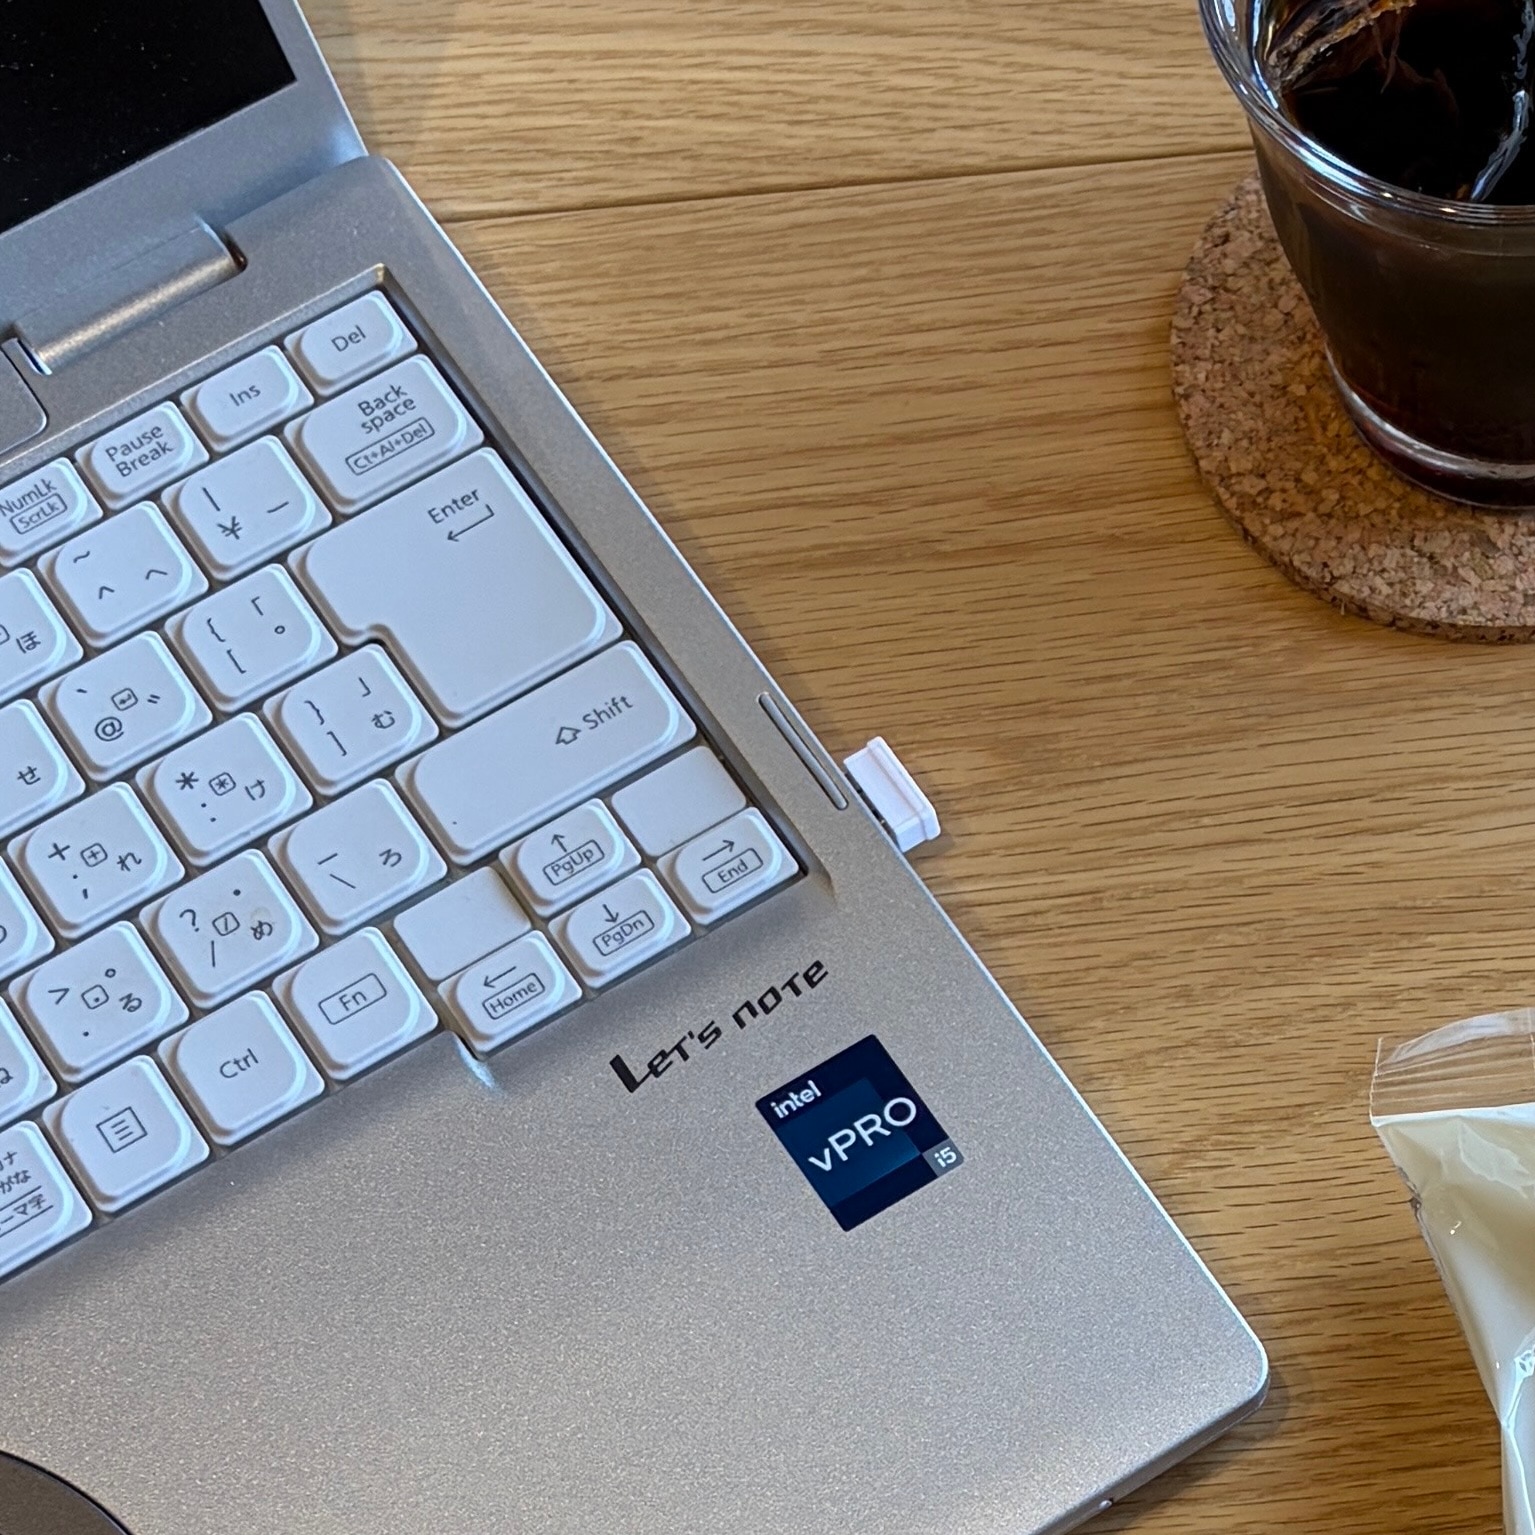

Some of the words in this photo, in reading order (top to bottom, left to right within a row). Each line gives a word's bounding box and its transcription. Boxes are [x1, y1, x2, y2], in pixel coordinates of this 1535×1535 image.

[331, 325, 366, 352] Del
[230, 383, 261, 407] Ins
[357, 383, 408, 418] Back
[360, 396, 416, 435] space
[105, 424, 164, 462] Pause
[116, 441, 174, 477] Break
[0, 479, 57, 517] NumLk
[428, 487, 481, 524] Enter
[18, 501, 60, 529] ScrLk
[582, 694, 634, 731] Shift
[551, 845, 595, 878] PgUp
[717, 858, 749, 884] End
[601, 917, 645, 948] PgDn
[339, 989, 368, 1013] Fn
[490, 980, 539, 1013] Home
[219, 1047, 259, 1079] Ctrl
[770, 1079, 822, 1119] intel
[807, 1096, 918, 1173] vPRO
[933, 1146, 957, 1168] i5
